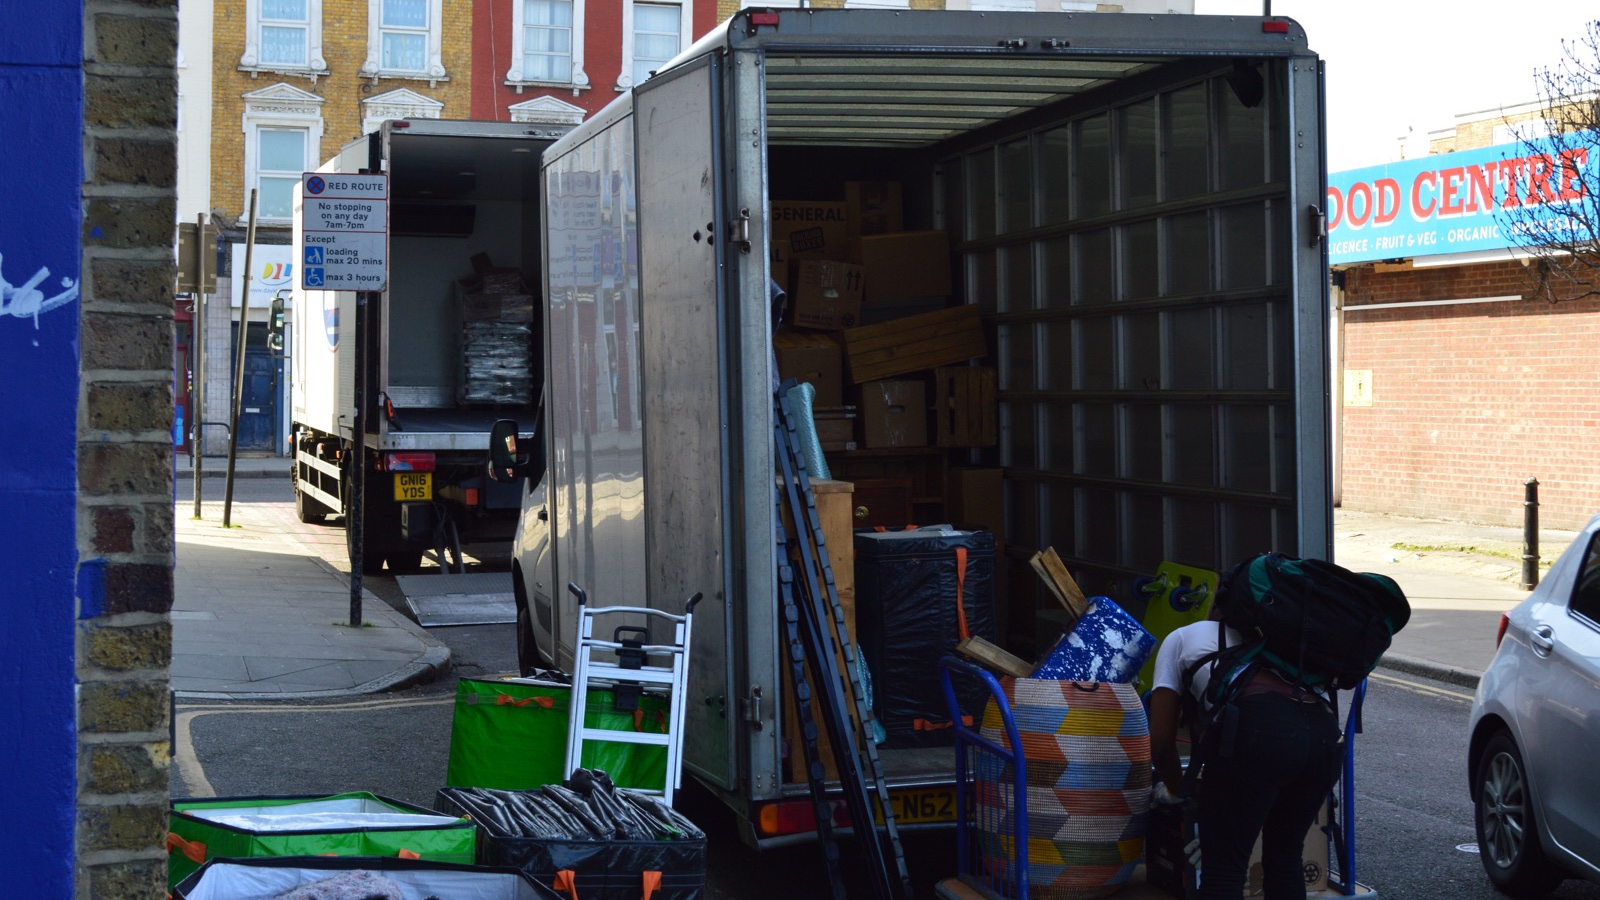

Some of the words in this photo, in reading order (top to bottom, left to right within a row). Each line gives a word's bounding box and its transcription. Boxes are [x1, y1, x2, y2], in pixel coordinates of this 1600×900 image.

[328, 182, 348, 191] RED
[351, 183, 384, 191] ROUTE
[1328, 178, 1401, 230] OOD
[1411, 147, 1589, 220] CENTRE
[318, 202, 331, 210] No
[333, 203, 372, 213] stopping
[335, 213, 349, 221] any
[353, 213, 368, 221] day
[772, 207, 845, 221] GENERAL
[325, 221, 365, 229] 7am-7pm
[305, 235, 336, 243] Except
[1328, 239, 1368, 255] LICENCE
[1375, 235, 1405, 250] FRUIT
[1407, 234, 1415, 247] &
[1417, 231, 1437, 245] VEG
[1447, 225, 1500, 243] ORGANIC
[326, 248, 358, 256] loading
[347, 257, 359, 265] 20
[362, 257, 383, 265] mins
[346, 273, 353, 281] 3
[356, 273, 381, 282] hours
[400, 474, 427, 486] GN16
[402, 487, 425, 498] YDS
